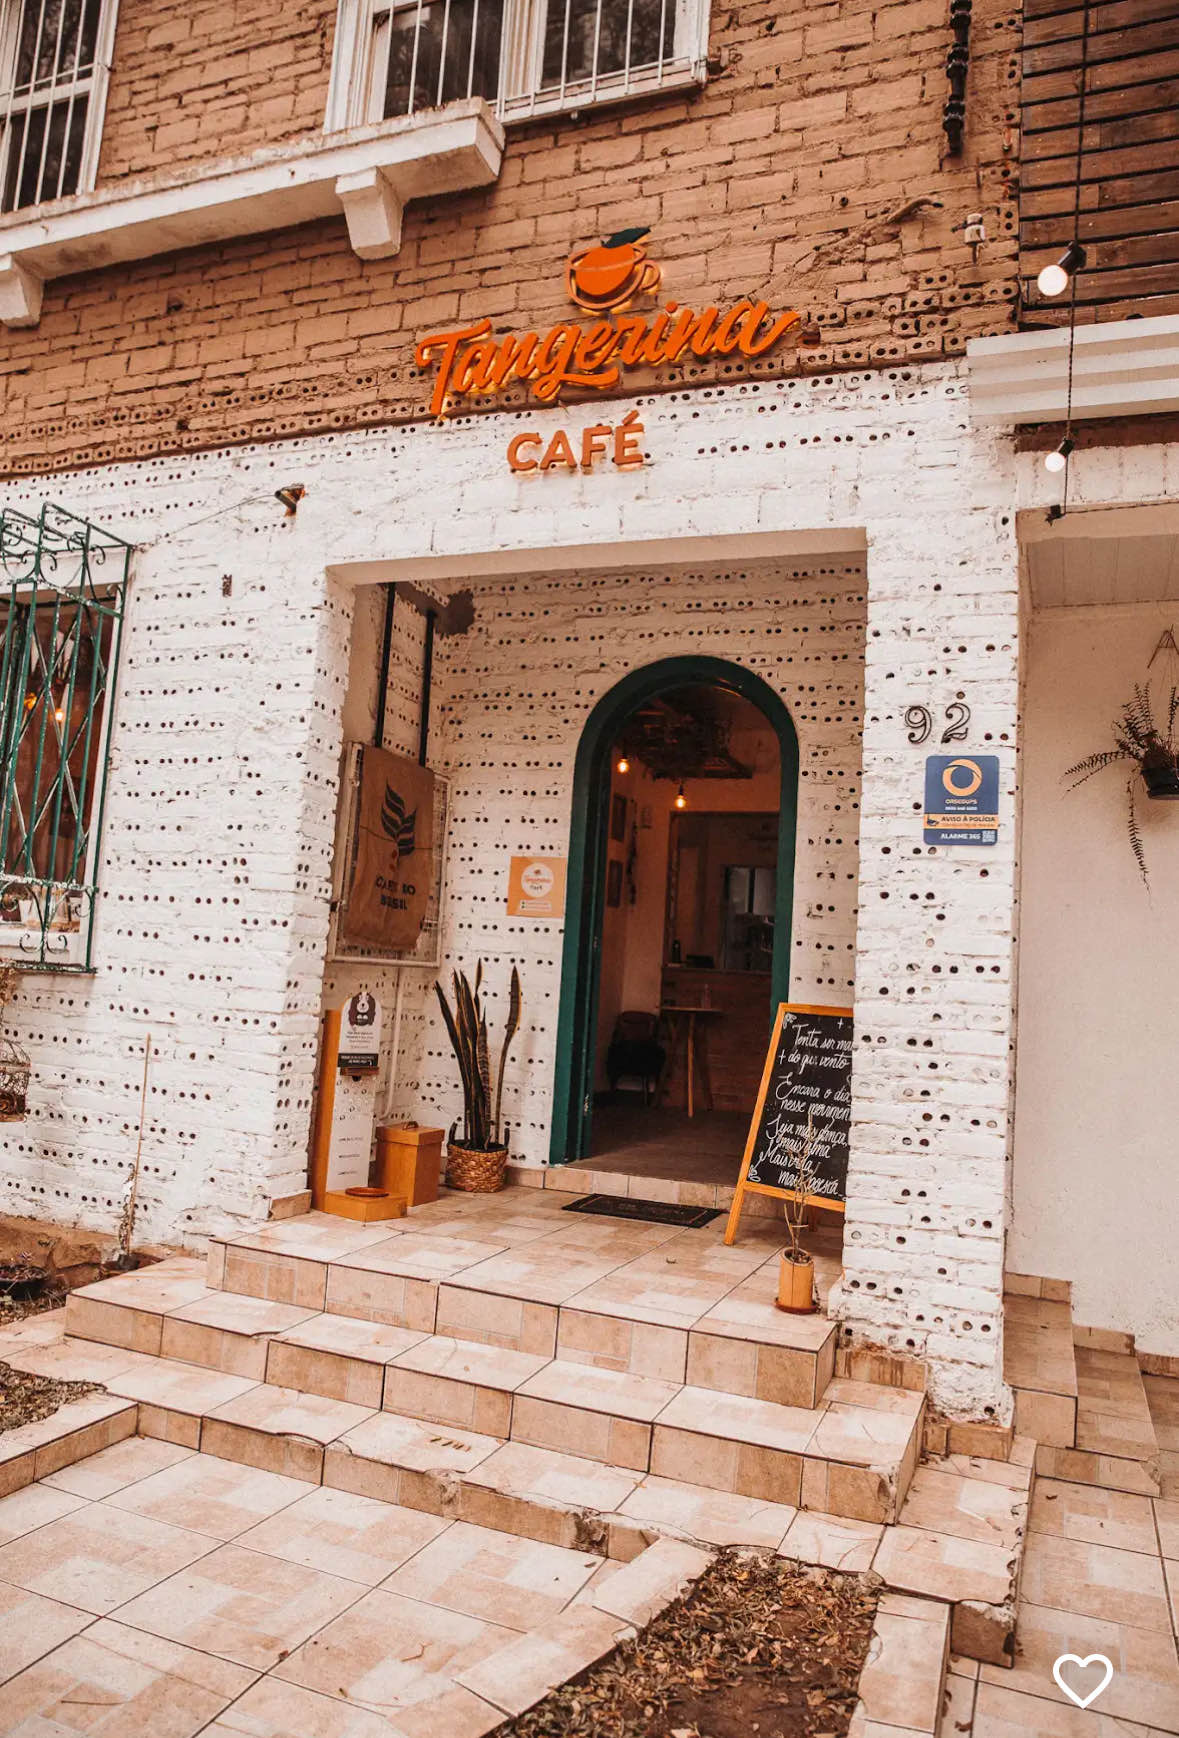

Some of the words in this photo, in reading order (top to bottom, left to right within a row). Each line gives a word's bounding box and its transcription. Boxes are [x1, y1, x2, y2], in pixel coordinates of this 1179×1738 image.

[415, 300, 801, 416] Tangerina
[506, 410, 645, 472] CAFÉ
[904, 702, 971, 744] 92
